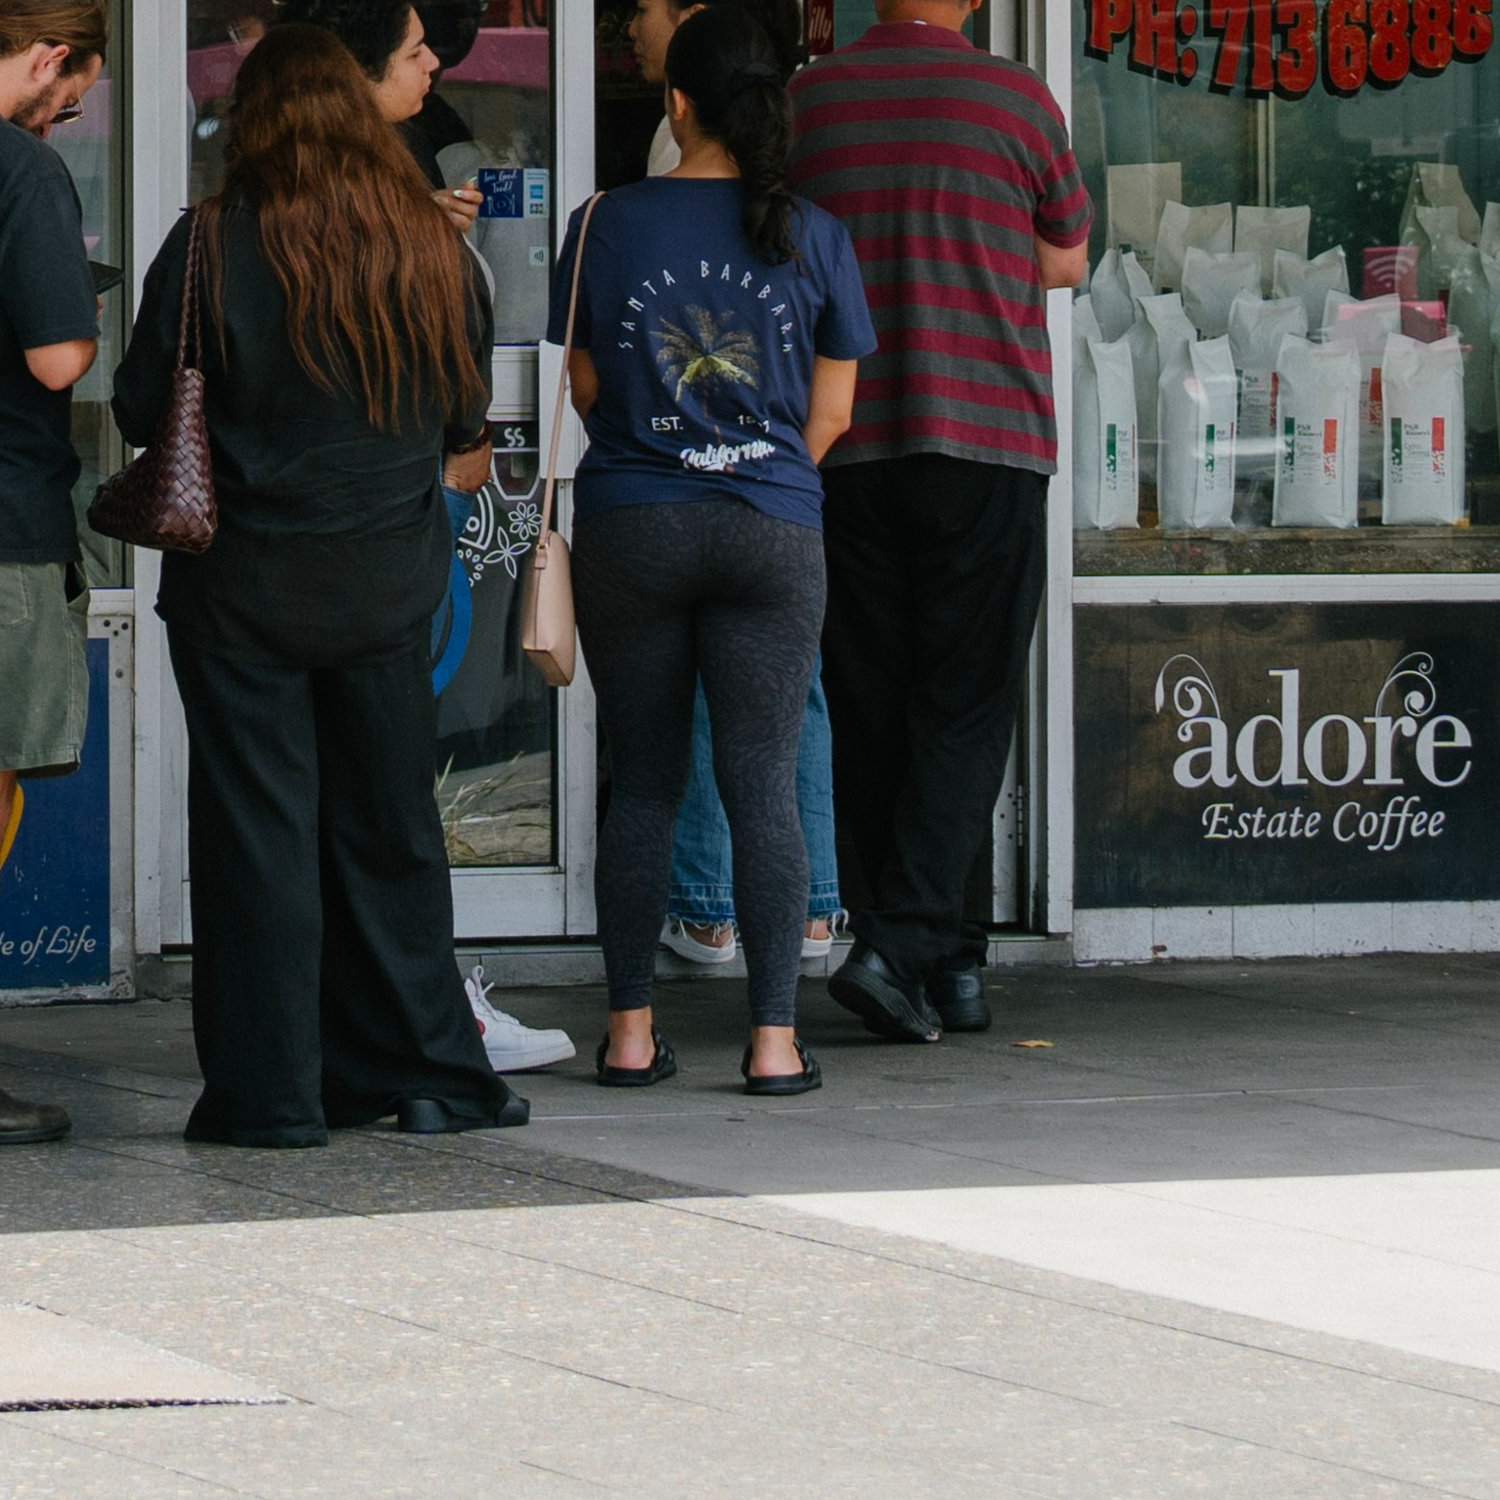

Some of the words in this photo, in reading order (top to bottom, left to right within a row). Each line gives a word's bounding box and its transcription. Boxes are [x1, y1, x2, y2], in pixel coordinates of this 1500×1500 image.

[809, 6, 832, 49] illy
[618, 268, 676, 350] SANTA
[652, 416, 684, 431] EST.
[1155, 652, 1473, 791] adore
[1202, 800, 1322, 842] Estate
[1331, 798, 1446, 852] Coffee
[19, 926, 44, 966] of
[45, 925, 98, 965] Life
